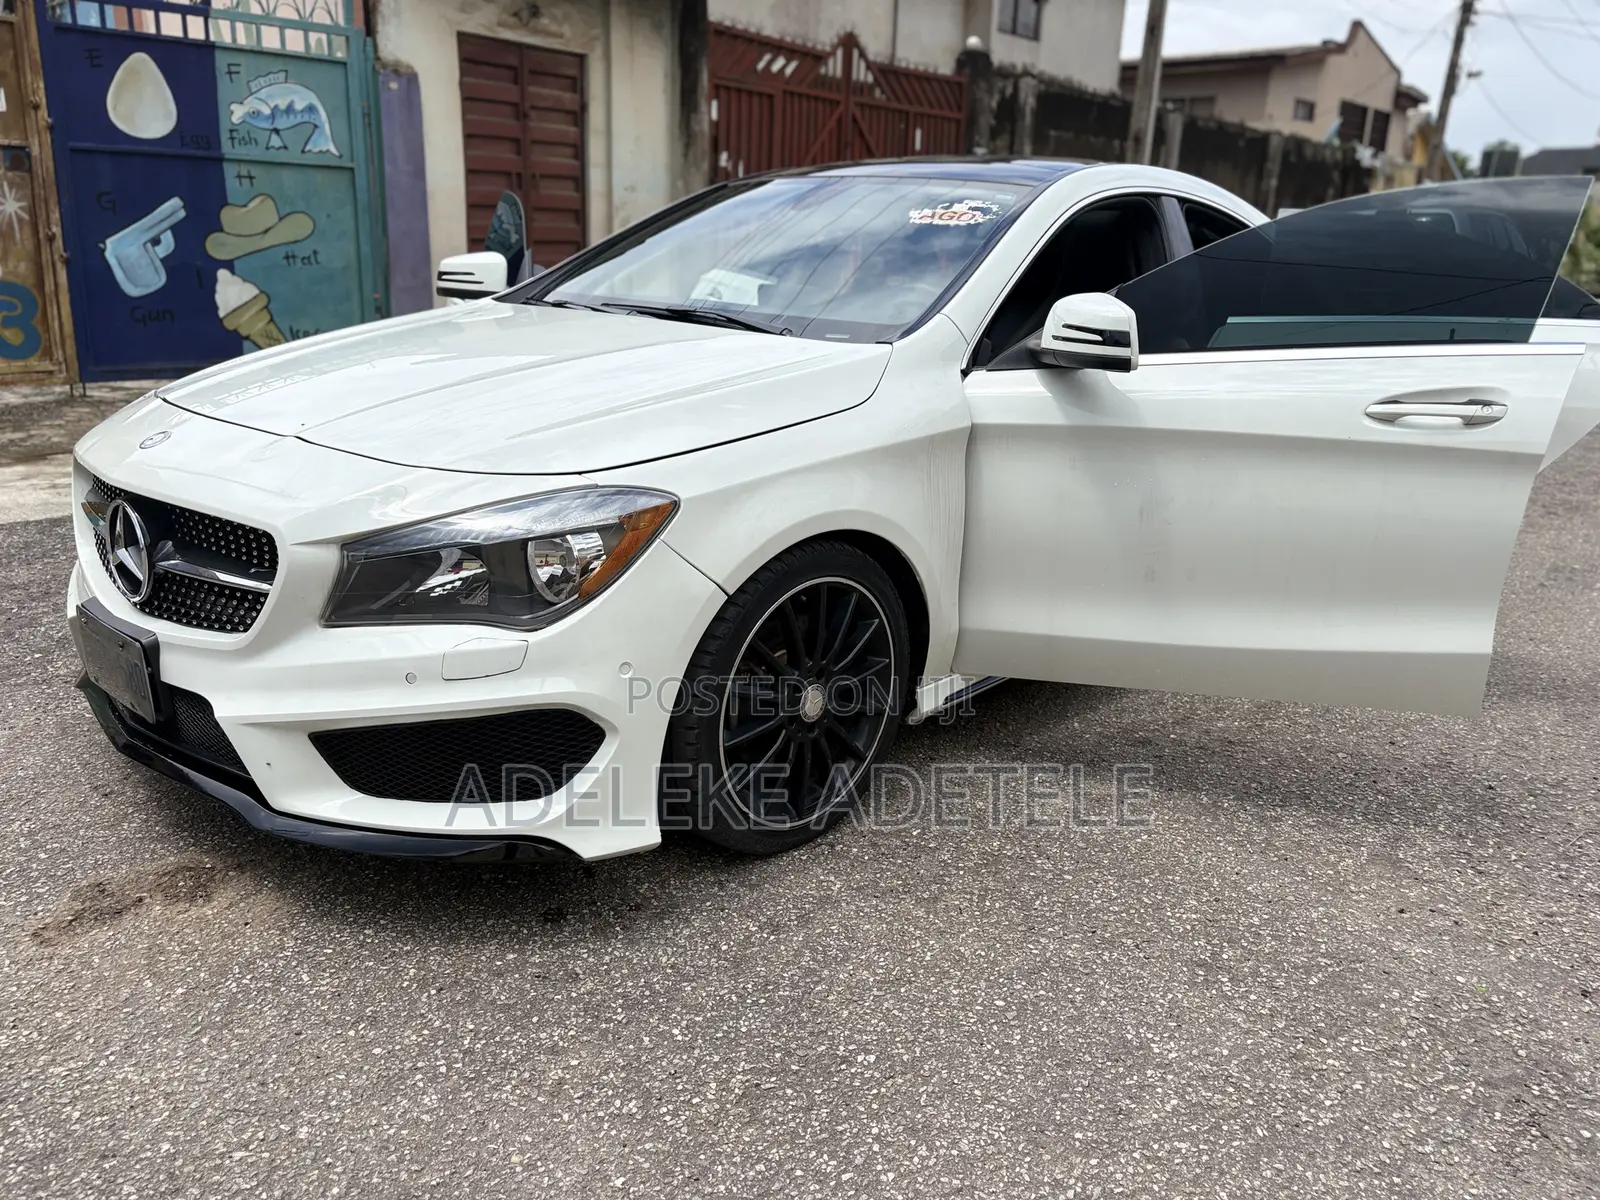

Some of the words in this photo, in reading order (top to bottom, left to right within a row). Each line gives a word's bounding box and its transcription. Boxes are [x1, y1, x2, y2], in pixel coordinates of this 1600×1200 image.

[225, 63, 242, 83] F
[180, 131, 212, 150] Egg
[228, 129, 259, 149] Fish
[235, 169, 256, 188] H
[96, 190, 116, 215] G
[283, 249, 321, 266] Hat
[130, 306, 175, 328] Gun
